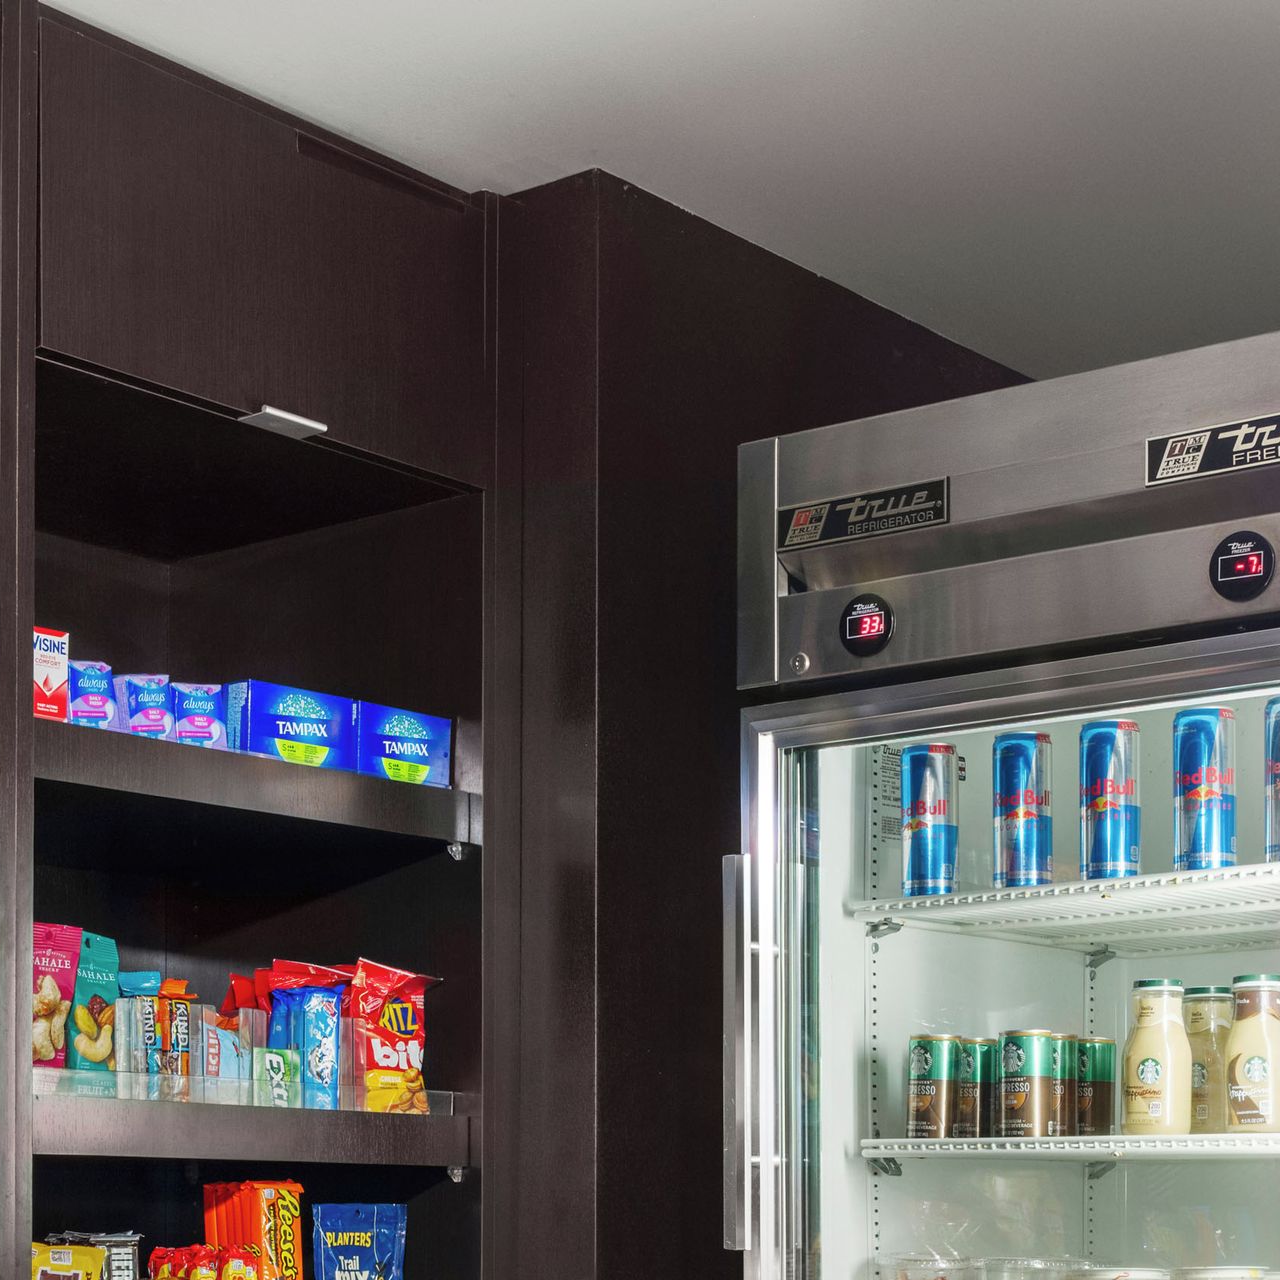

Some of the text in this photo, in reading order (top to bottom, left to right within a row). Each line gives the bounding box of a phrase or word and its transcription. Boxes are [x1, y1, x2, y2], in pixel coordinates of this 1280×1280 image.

[836, 491, 935, 523] true
[848, 511, 934, 534] REFRIGERATOR
[78, 676, 108, 690] always
[183, 699, 215, 712] always
[276, 721, 328, 737] TAMPAX
[383, 741, 429, 756] TAMPAX
[1206, 767, 1234, 784] Bull
[1103, 779, 1135, 796] Bull
[77, 968, 116, 981] SAHALE
[175, 1003, 188, 1046] KIND
[379, 1002, 418, 1032] RITZ
[278, 1189, 301, 1280] Reese's
[326, 1232, 372, 1247] PLANTERS
[339, 1256, 359, 1271] Trail
